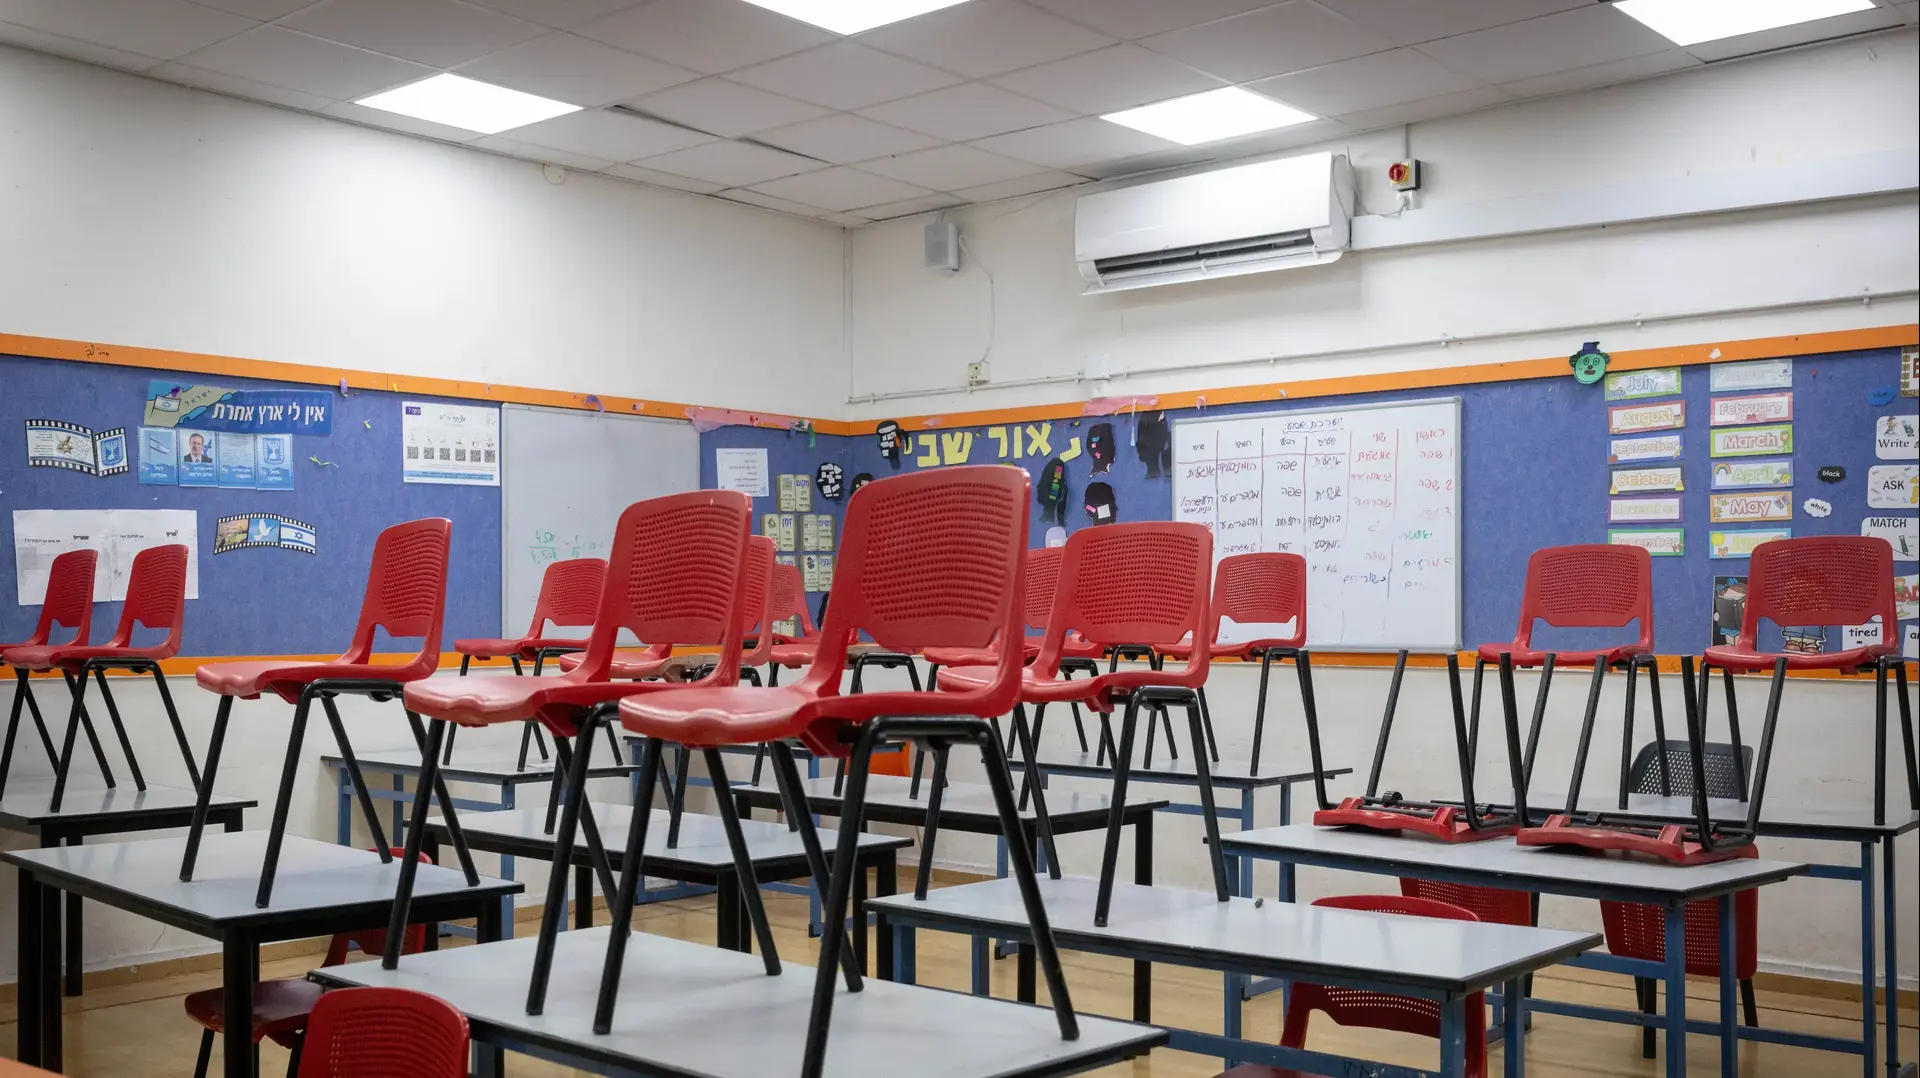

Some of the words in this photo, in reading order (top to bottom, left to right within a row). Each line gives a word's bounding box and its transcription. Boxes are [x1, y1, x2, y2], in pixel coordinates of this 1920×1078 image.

[1626, 375, 1658, 392] July
[212, 403, 254, 421] אחרת
[258, 404, 283, 424] ארץ
[288, 402, 301, 420] לי
[305, 405, 325, 425] אין
[1720, 402, 1782, 415] February
[1622, 407, 1673, 426] August
[1416, 429, 1444, 443] ראשון
[1723, 432, 1777, 450] March
[1613, 441, 1679, 456] September
[1878, 439, 1910, 448] Write
[1276, 460, 1298, 471] שפה
[1616, 472, 1677, 486] October
[1732, 465, 1774, 484] April
[1822, 469, 1841, 478] black
[1281, 486, 1302, 497] שפה
[1883, 480, 1905, 490] ASK
[1730, 499, 1771, 517] May
[1810, 502, 1828, 513] white
[1870, 519, 1907, 528] MATCH
[1848, 627, 1878, 637] tired
